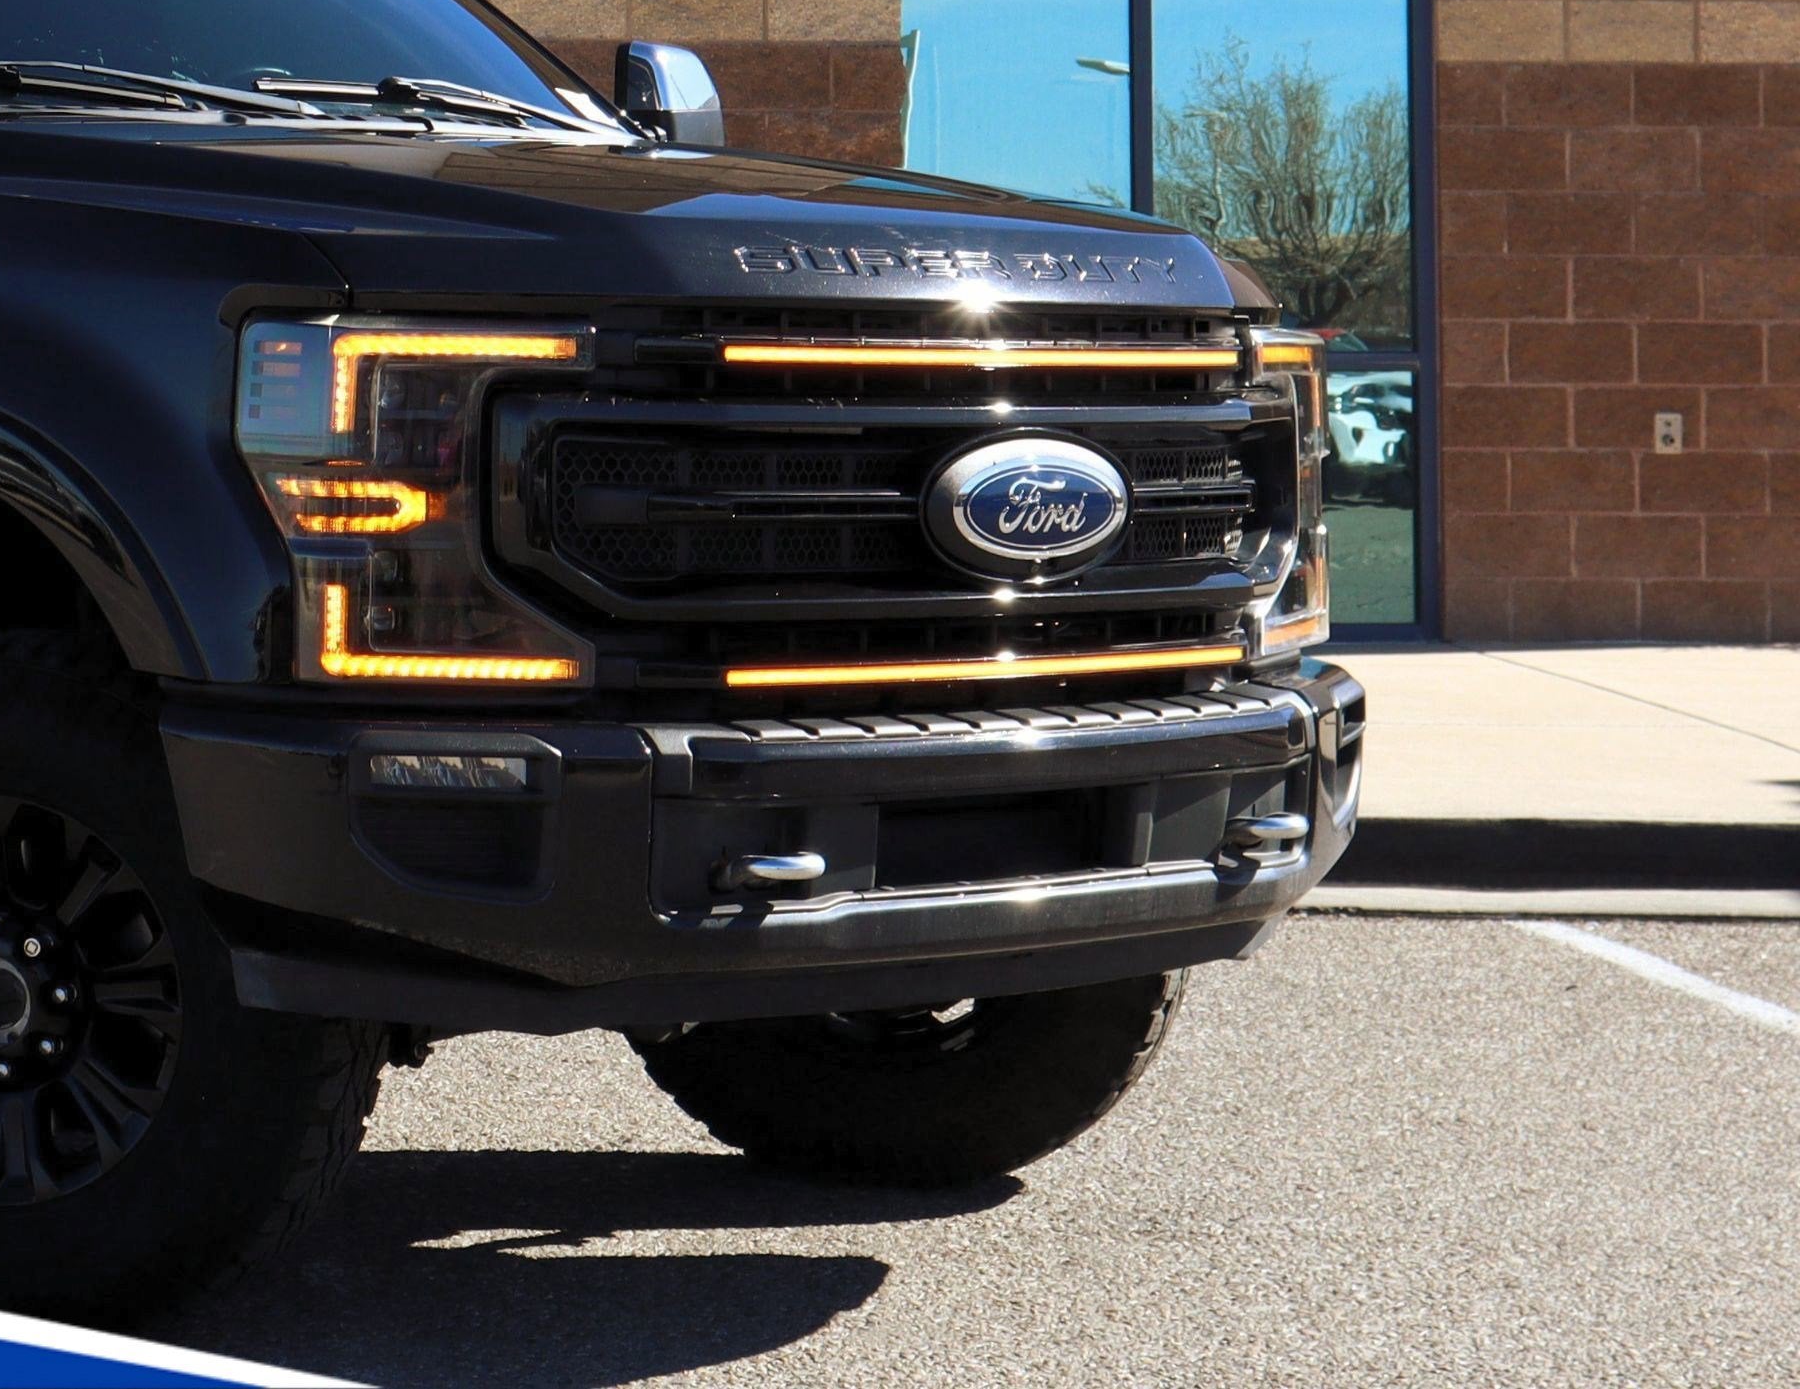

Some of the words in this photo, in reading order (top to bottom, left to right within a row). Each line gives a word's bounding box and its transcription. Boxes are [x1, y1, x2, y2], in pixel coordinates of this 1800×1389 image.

[733, 245, 1012, 280] SUPER
[1013, 253, 1177, 284] DUTY
[998, 477, 1088, 535] Ford
